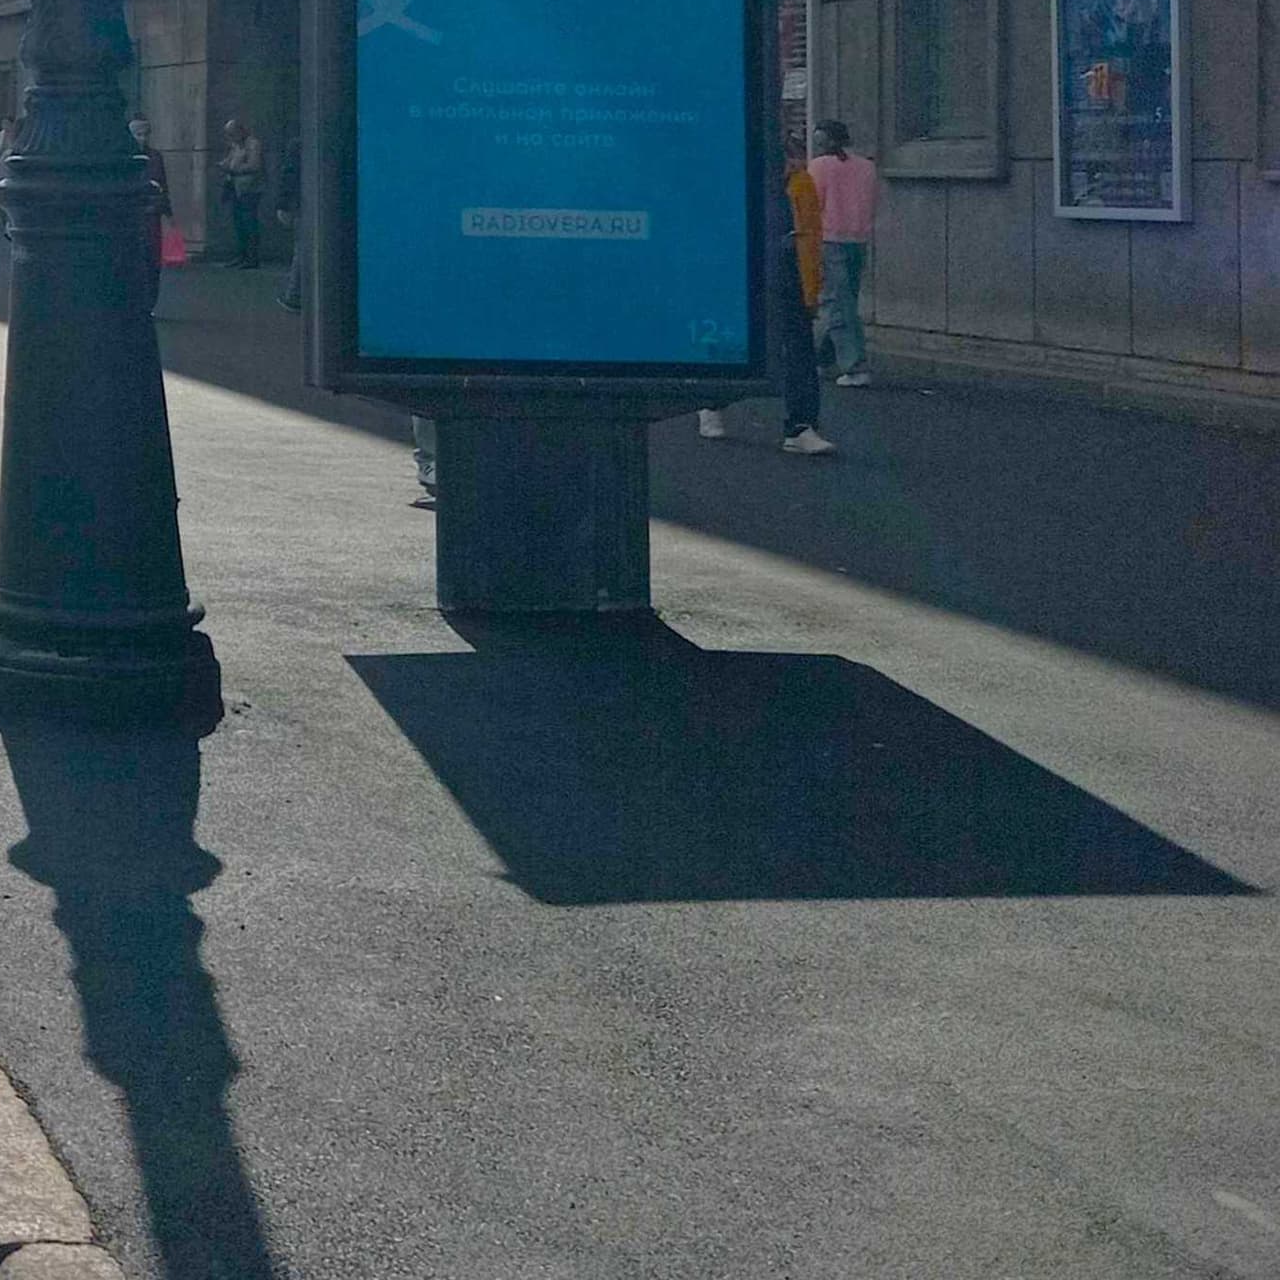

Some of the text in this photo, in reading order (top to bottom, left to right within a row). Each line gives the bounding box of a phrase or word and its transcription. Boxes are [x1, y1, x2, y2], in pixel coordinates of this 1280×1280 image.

[453, 76, 566, 97] Слушайте
[471, 214, 641, 235] RADIOVERA.RU
[687, 318, 736, 345] 12+
